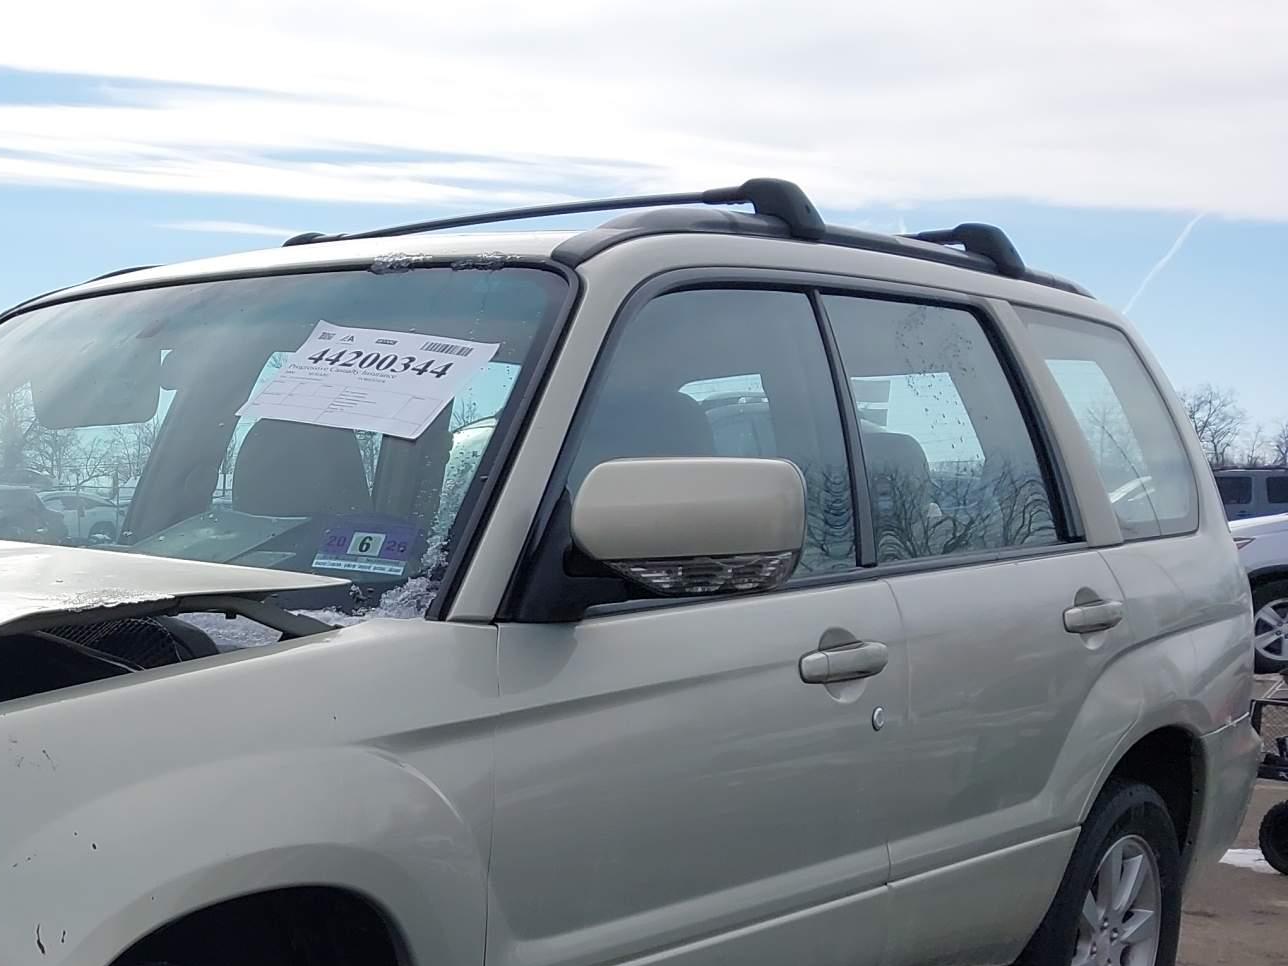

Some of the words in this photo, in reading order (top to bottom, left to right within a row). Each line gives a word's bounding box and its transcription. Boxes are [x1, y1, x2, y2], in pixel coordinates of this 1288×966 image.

[308, 347, 454, 379] 44200344
[327, 535, 347, 548] 20
[358, 535, 372, 553] 6
